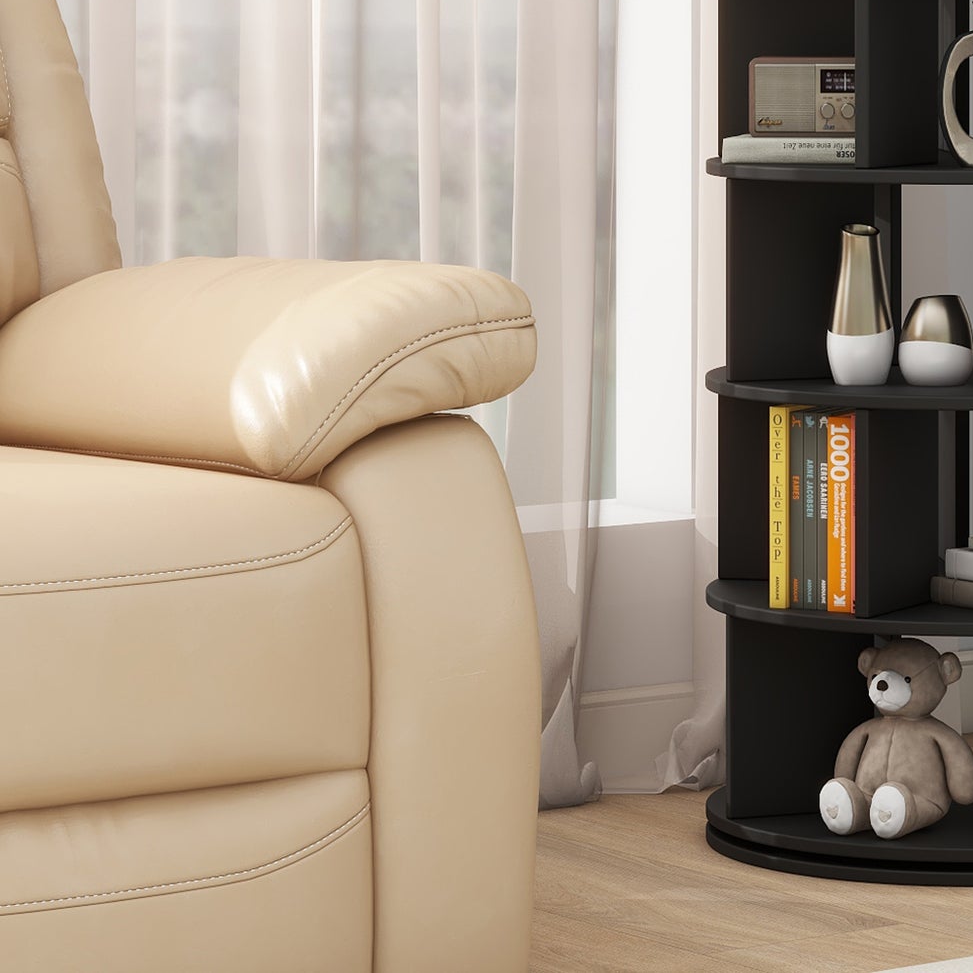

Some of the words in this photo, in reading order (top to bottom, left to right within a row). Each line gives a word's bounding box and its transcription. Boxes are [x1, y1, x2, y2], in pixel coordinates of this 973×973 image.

[773, 413, 782, 460] Over
[830, 423, 850, 482] 1000
[792, 475, 800, 500] EAMES
[806, 459, 814, 479] ARNE
[820, 462, 828, 481] EERO
[806, 480, 814, 518] JACOBSEN
[820, 483, 828, 519] SAARINEN
[773, 520, 782, 560] Top
